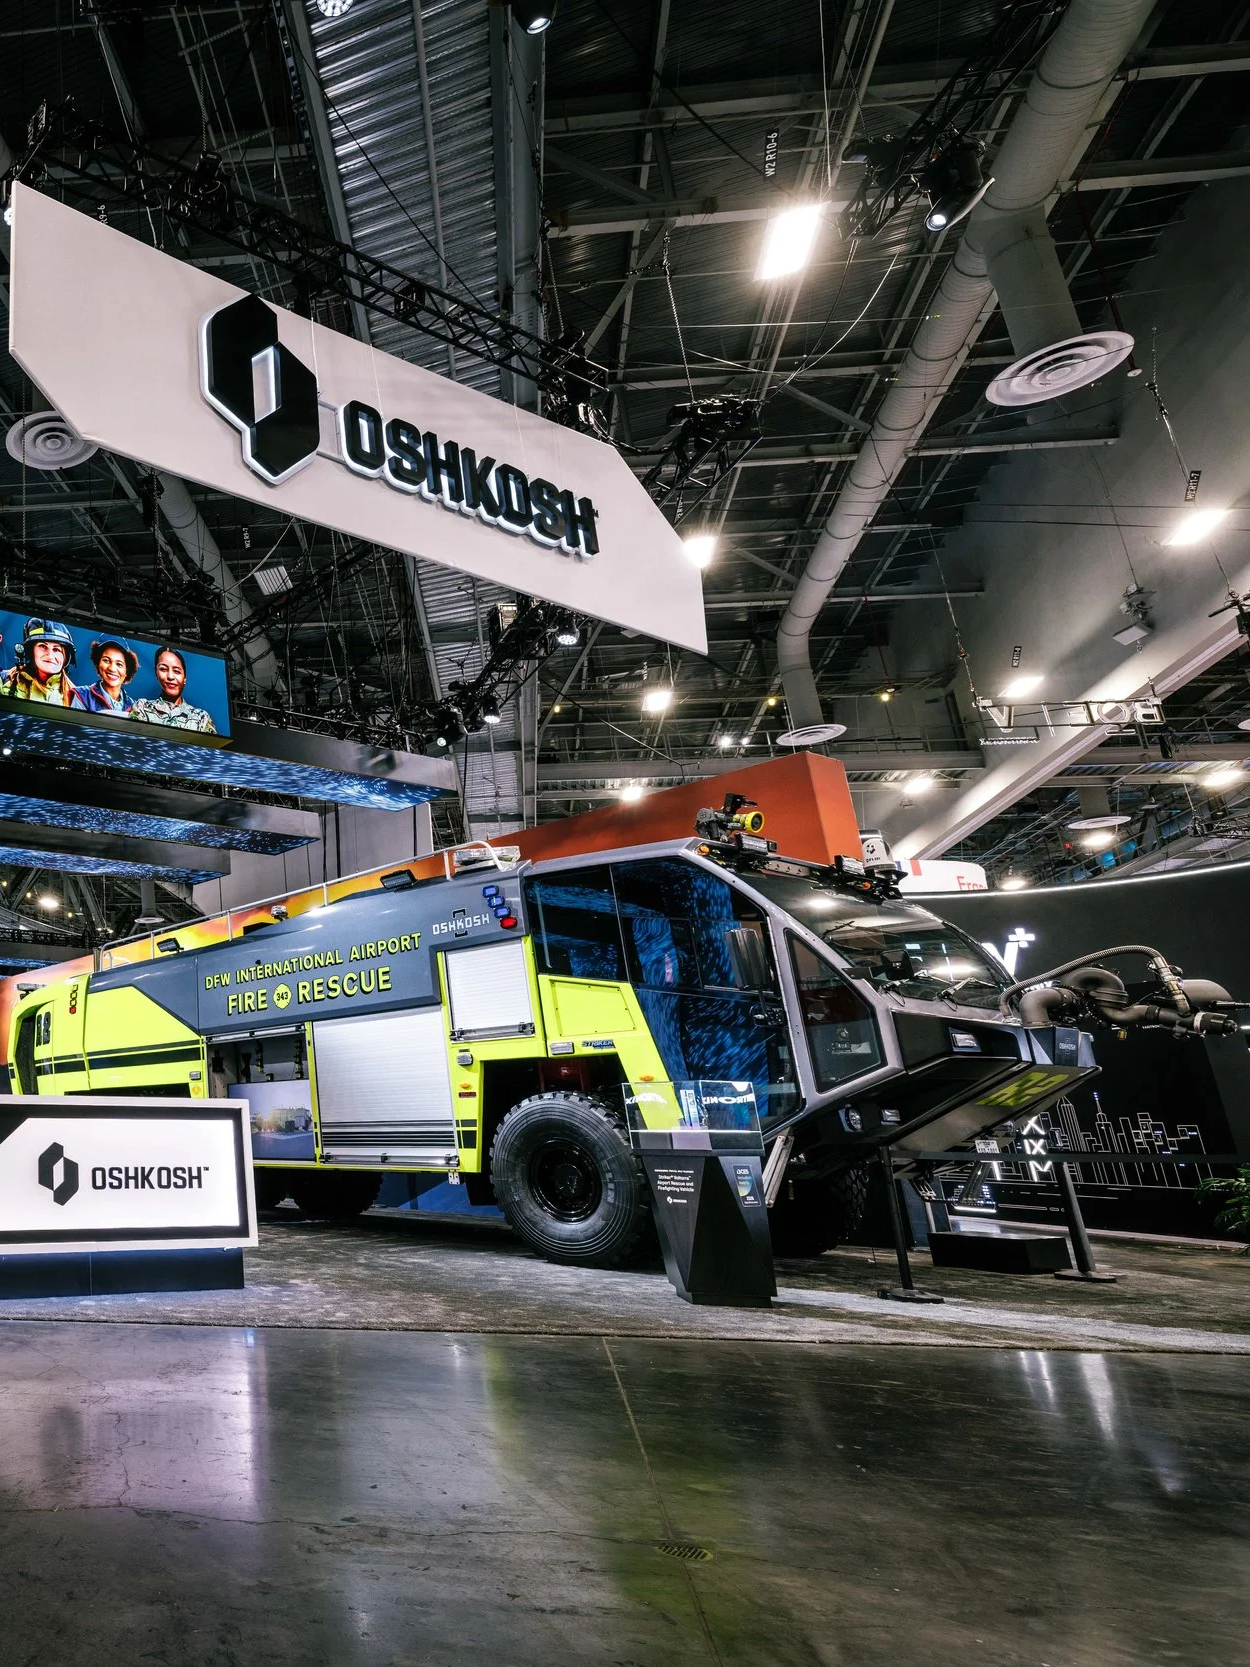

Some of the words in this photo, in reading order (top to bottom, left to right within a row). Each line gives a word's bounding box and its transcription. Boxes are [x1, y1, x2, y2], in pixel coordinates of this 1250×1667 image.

[765, 132, 778, 161] R10-6
[764, 161, 776, 177] W2
[341, 399, 600, 556] OSHKOSH
[432, 913, 490, 935] OSHKOSH
[205, 971, 231, 990] DFW
[235, 949, 343, 985] INTERNATIONAL
[348, 932, 422, 963] AIRPORT
[227, 988, 268, 1016] FIRE
[276, 991, 289, 1001] 343
[297, 966, 392, 1005] RESCUE
[582, 1039, 613, 1047] STRIKER
